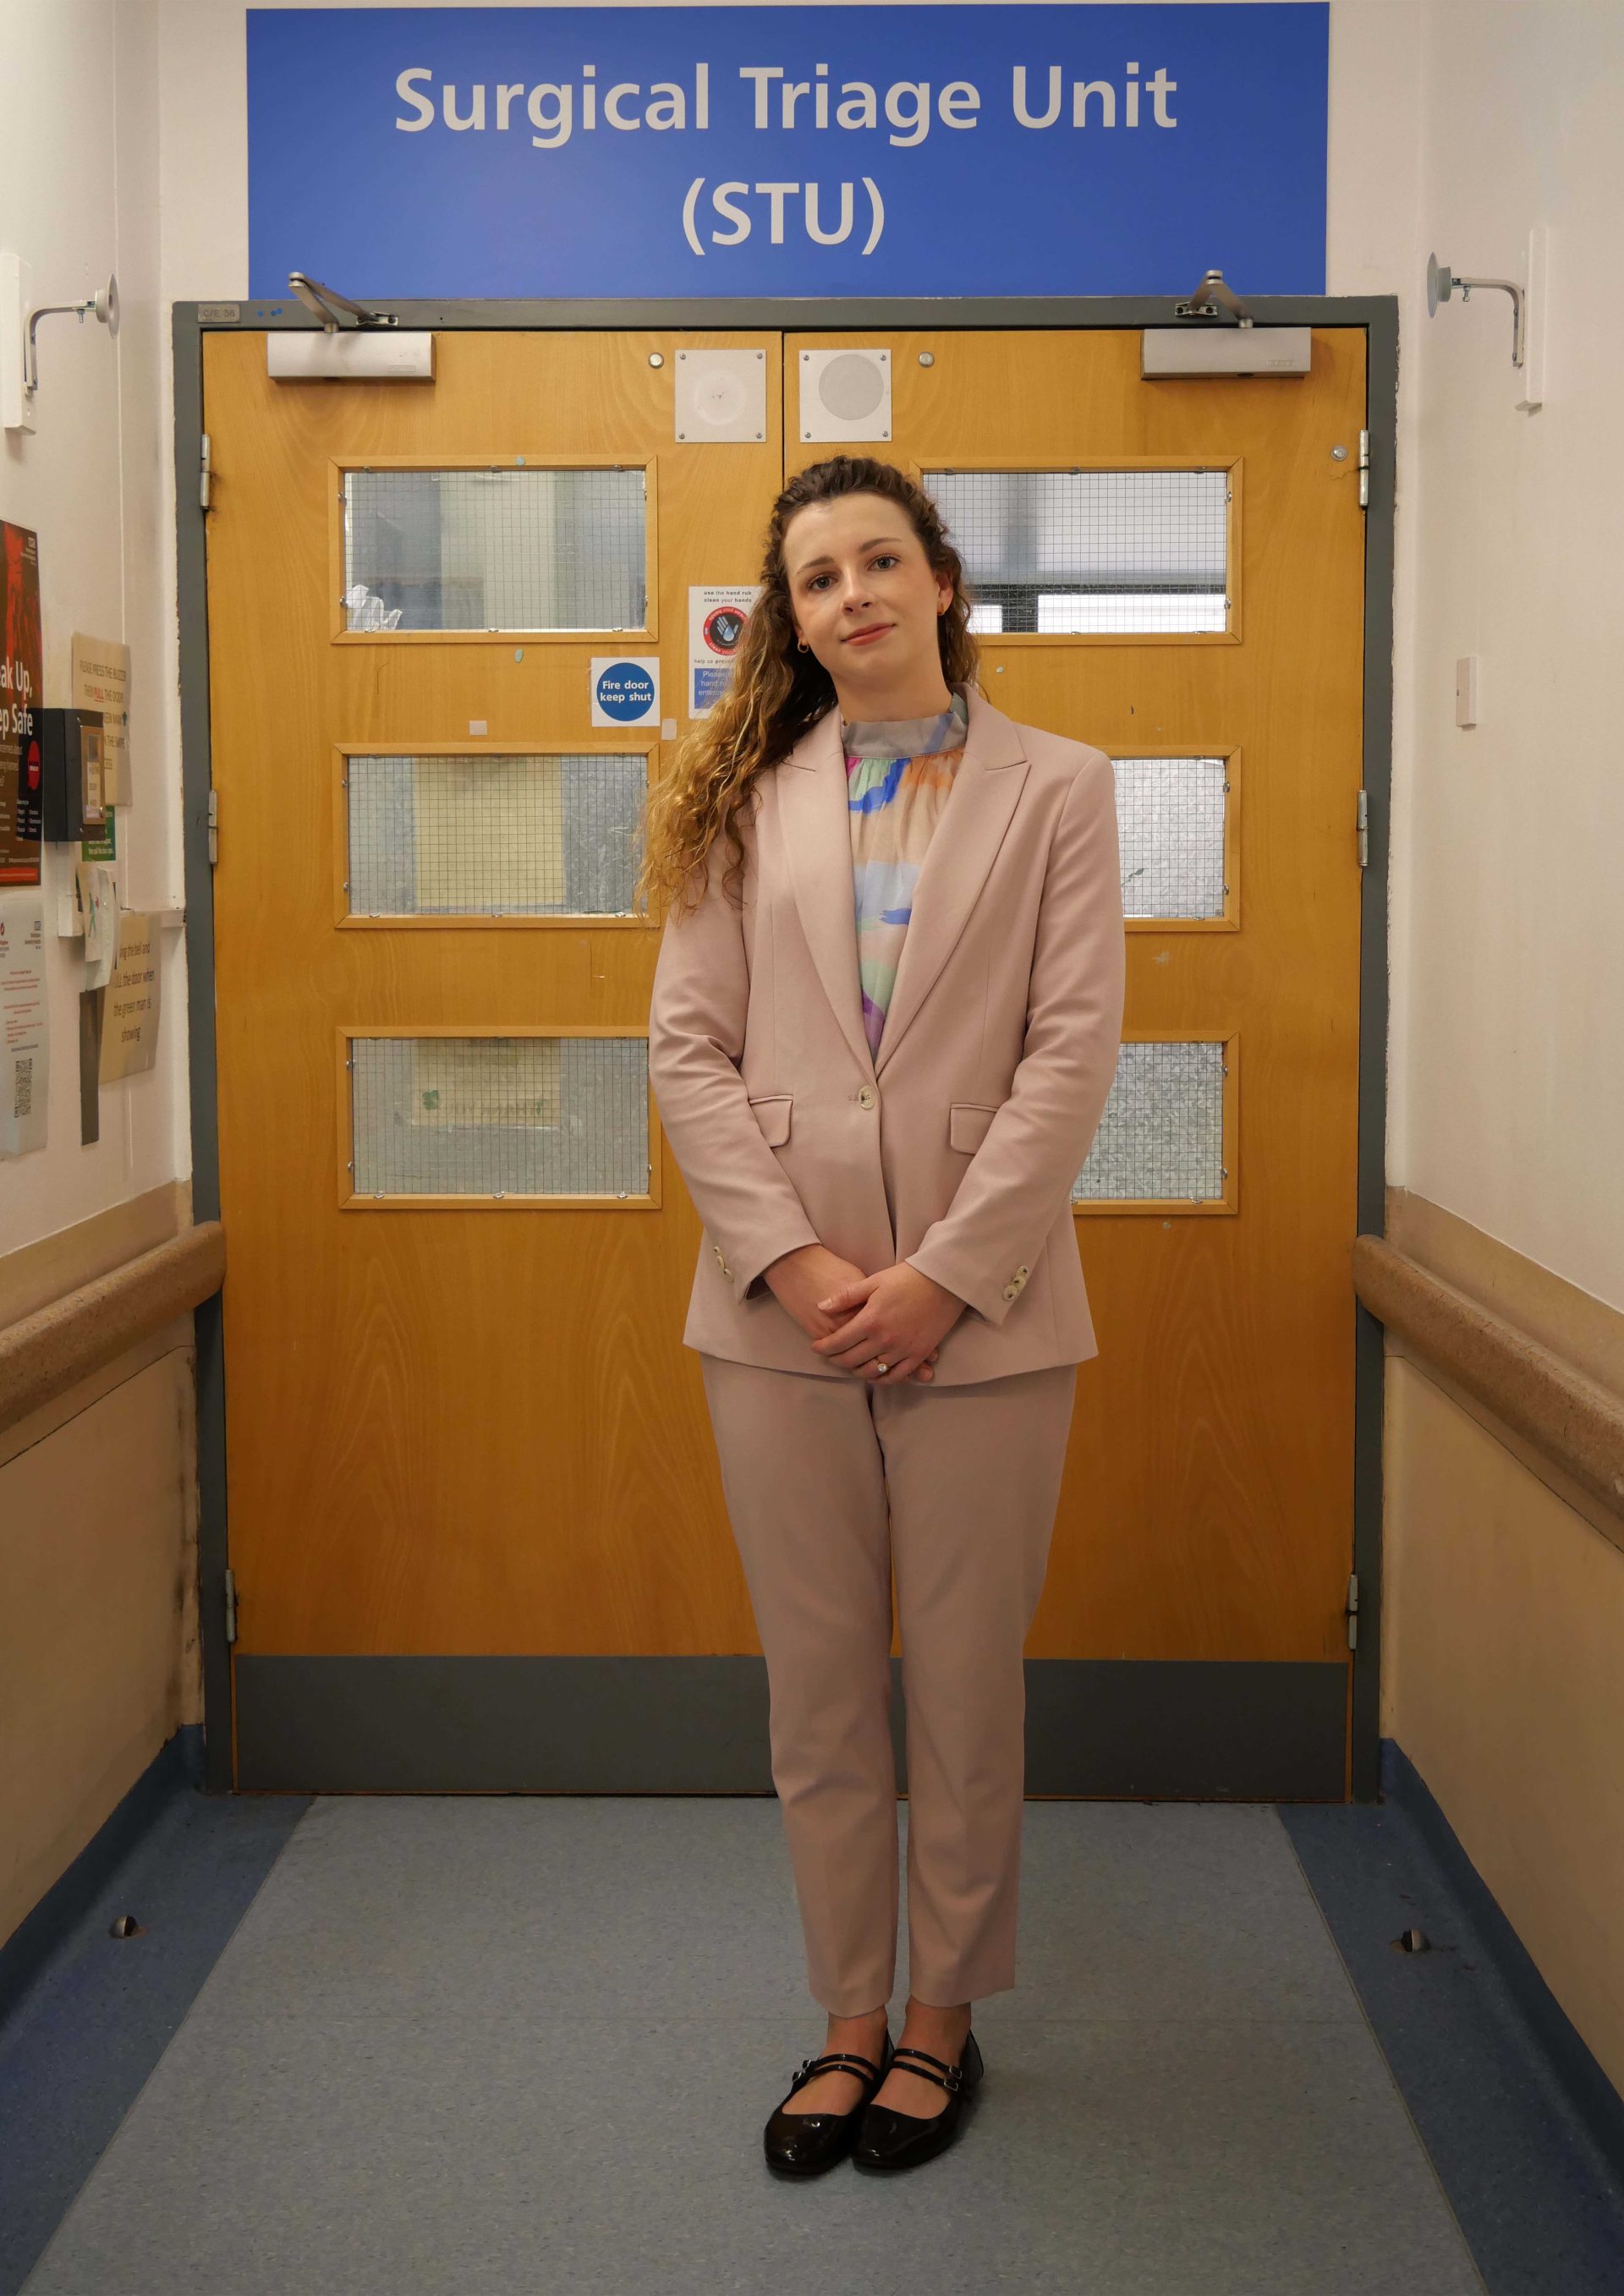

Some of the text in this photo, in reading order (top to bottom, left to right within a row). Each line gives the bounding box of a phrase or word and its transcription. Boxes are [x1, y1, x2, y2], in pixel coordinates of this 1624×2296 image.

[396, 63, 1177, 148] Surgical Triage Unit
[683, 178, 884, 255] (STU)
[223, 310, 235, 318] 36
[0, 656, 33, 701] eak Up,
[602, 680, 650, 690] Fire door
[104, 688, 112, 702] THE
[600, 692, 652, 703] keep shut
[12, 703, 33, 736] Safe
[142, 941, 151, 955] and
[123, 972, 131, 987] the
[131, 970, 143, 985] door
[143, 968, 155, 983] when
[113, 1002, 123, 1017] the
[123, 1001, 135, 1019] green
[136, 999, 146, 1011] man
[121, 1026, 141, 1043] showing
